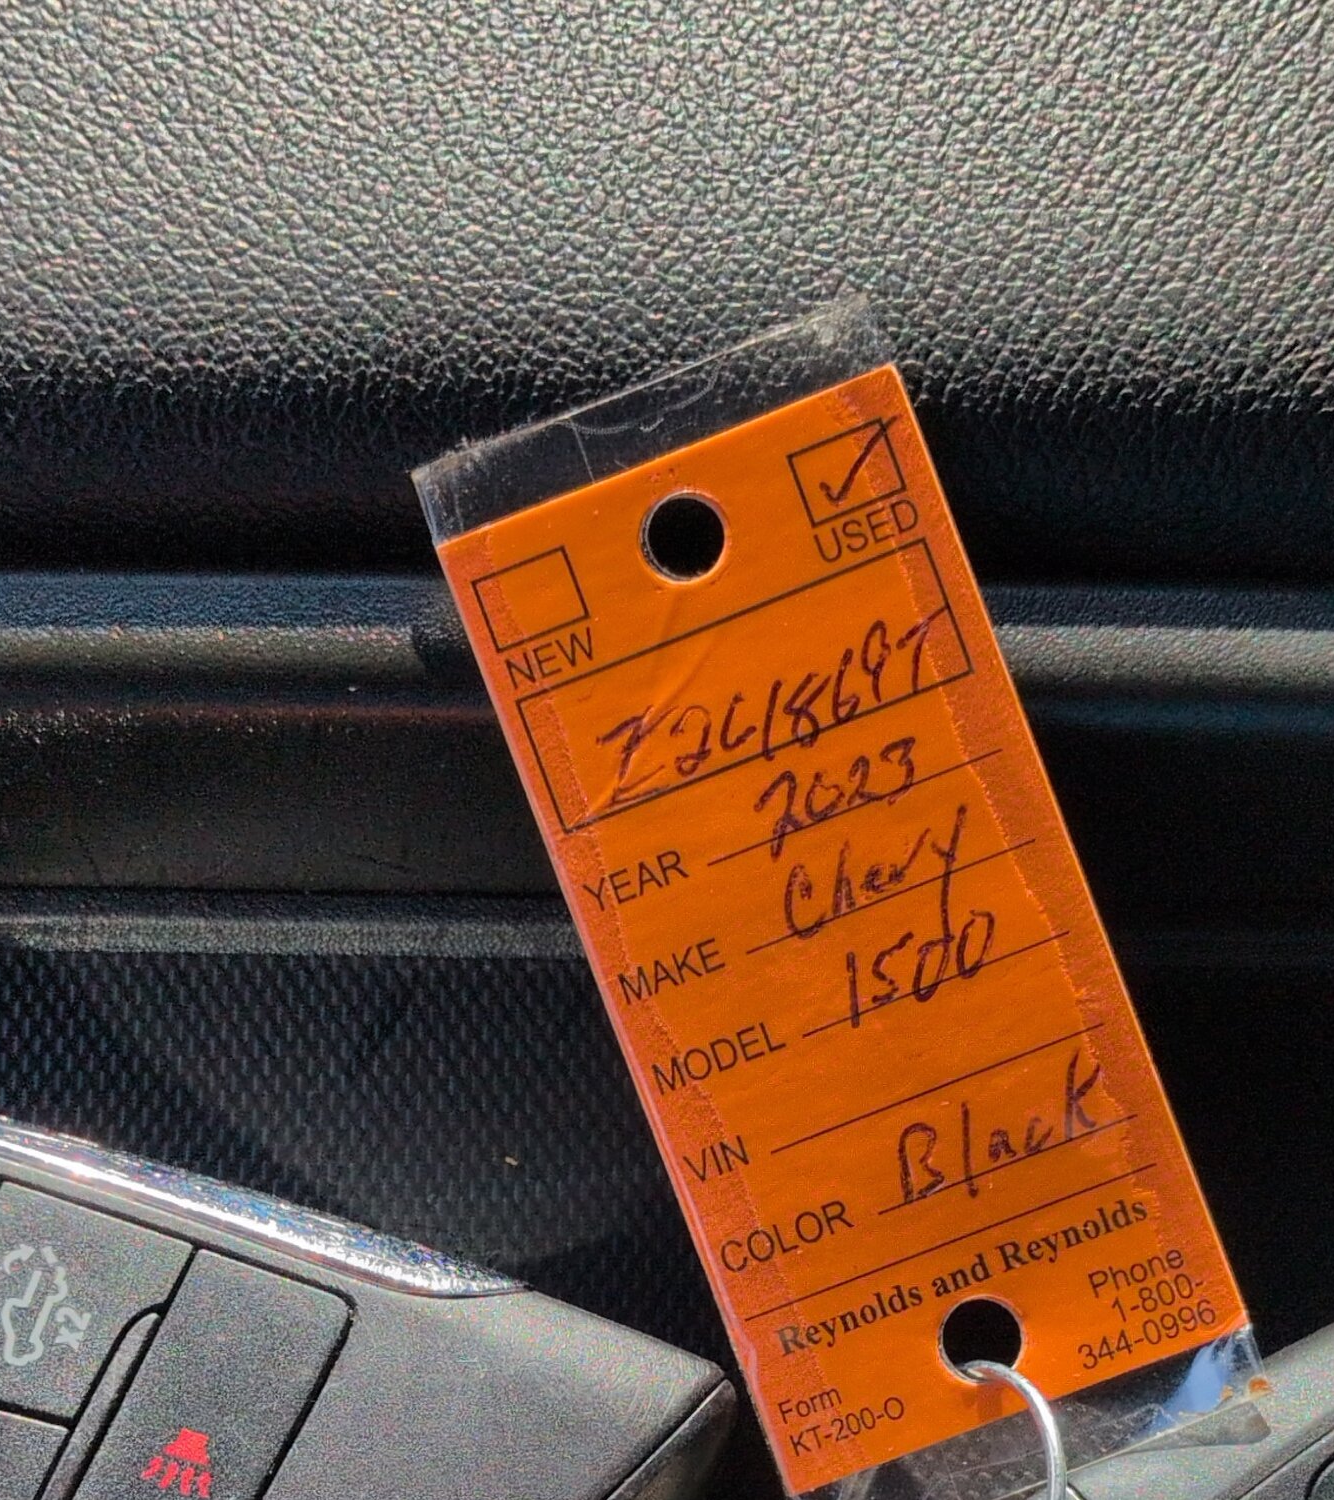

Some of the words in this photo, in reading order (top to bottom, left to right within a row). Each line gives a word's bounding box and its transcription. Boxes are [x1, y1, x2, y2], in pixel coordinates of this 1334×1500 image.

[813, 499, 921, 565] USED
[505, 629, 595, 691] NEW
[755, 737, 916, 860] 2023
[582, 849, 689, 913] YEAR
[784, 805, 967, 942] Chevy
[618, 938, 726, 1006] MAKE
[847, 909, 996, 1029] 1500
[651, 1021, 787, 1096] MODEL
[683, 1135, 750, 1183] VIN
[718, 1200, 853, 1275] COLOR
[776, 1283, 924, 1358] Reynolds
[932, 1255, 993, 1303] and
[998, 1197, 1150, 1277] Reynolds
[1088, 1247, 1185, 1298] Phone
[1110, 1273, 1205, 1324] 1-800-
[1077, 1299, 1217, 1372] 344-0996
[777, 1383, 843, 1426] Form
